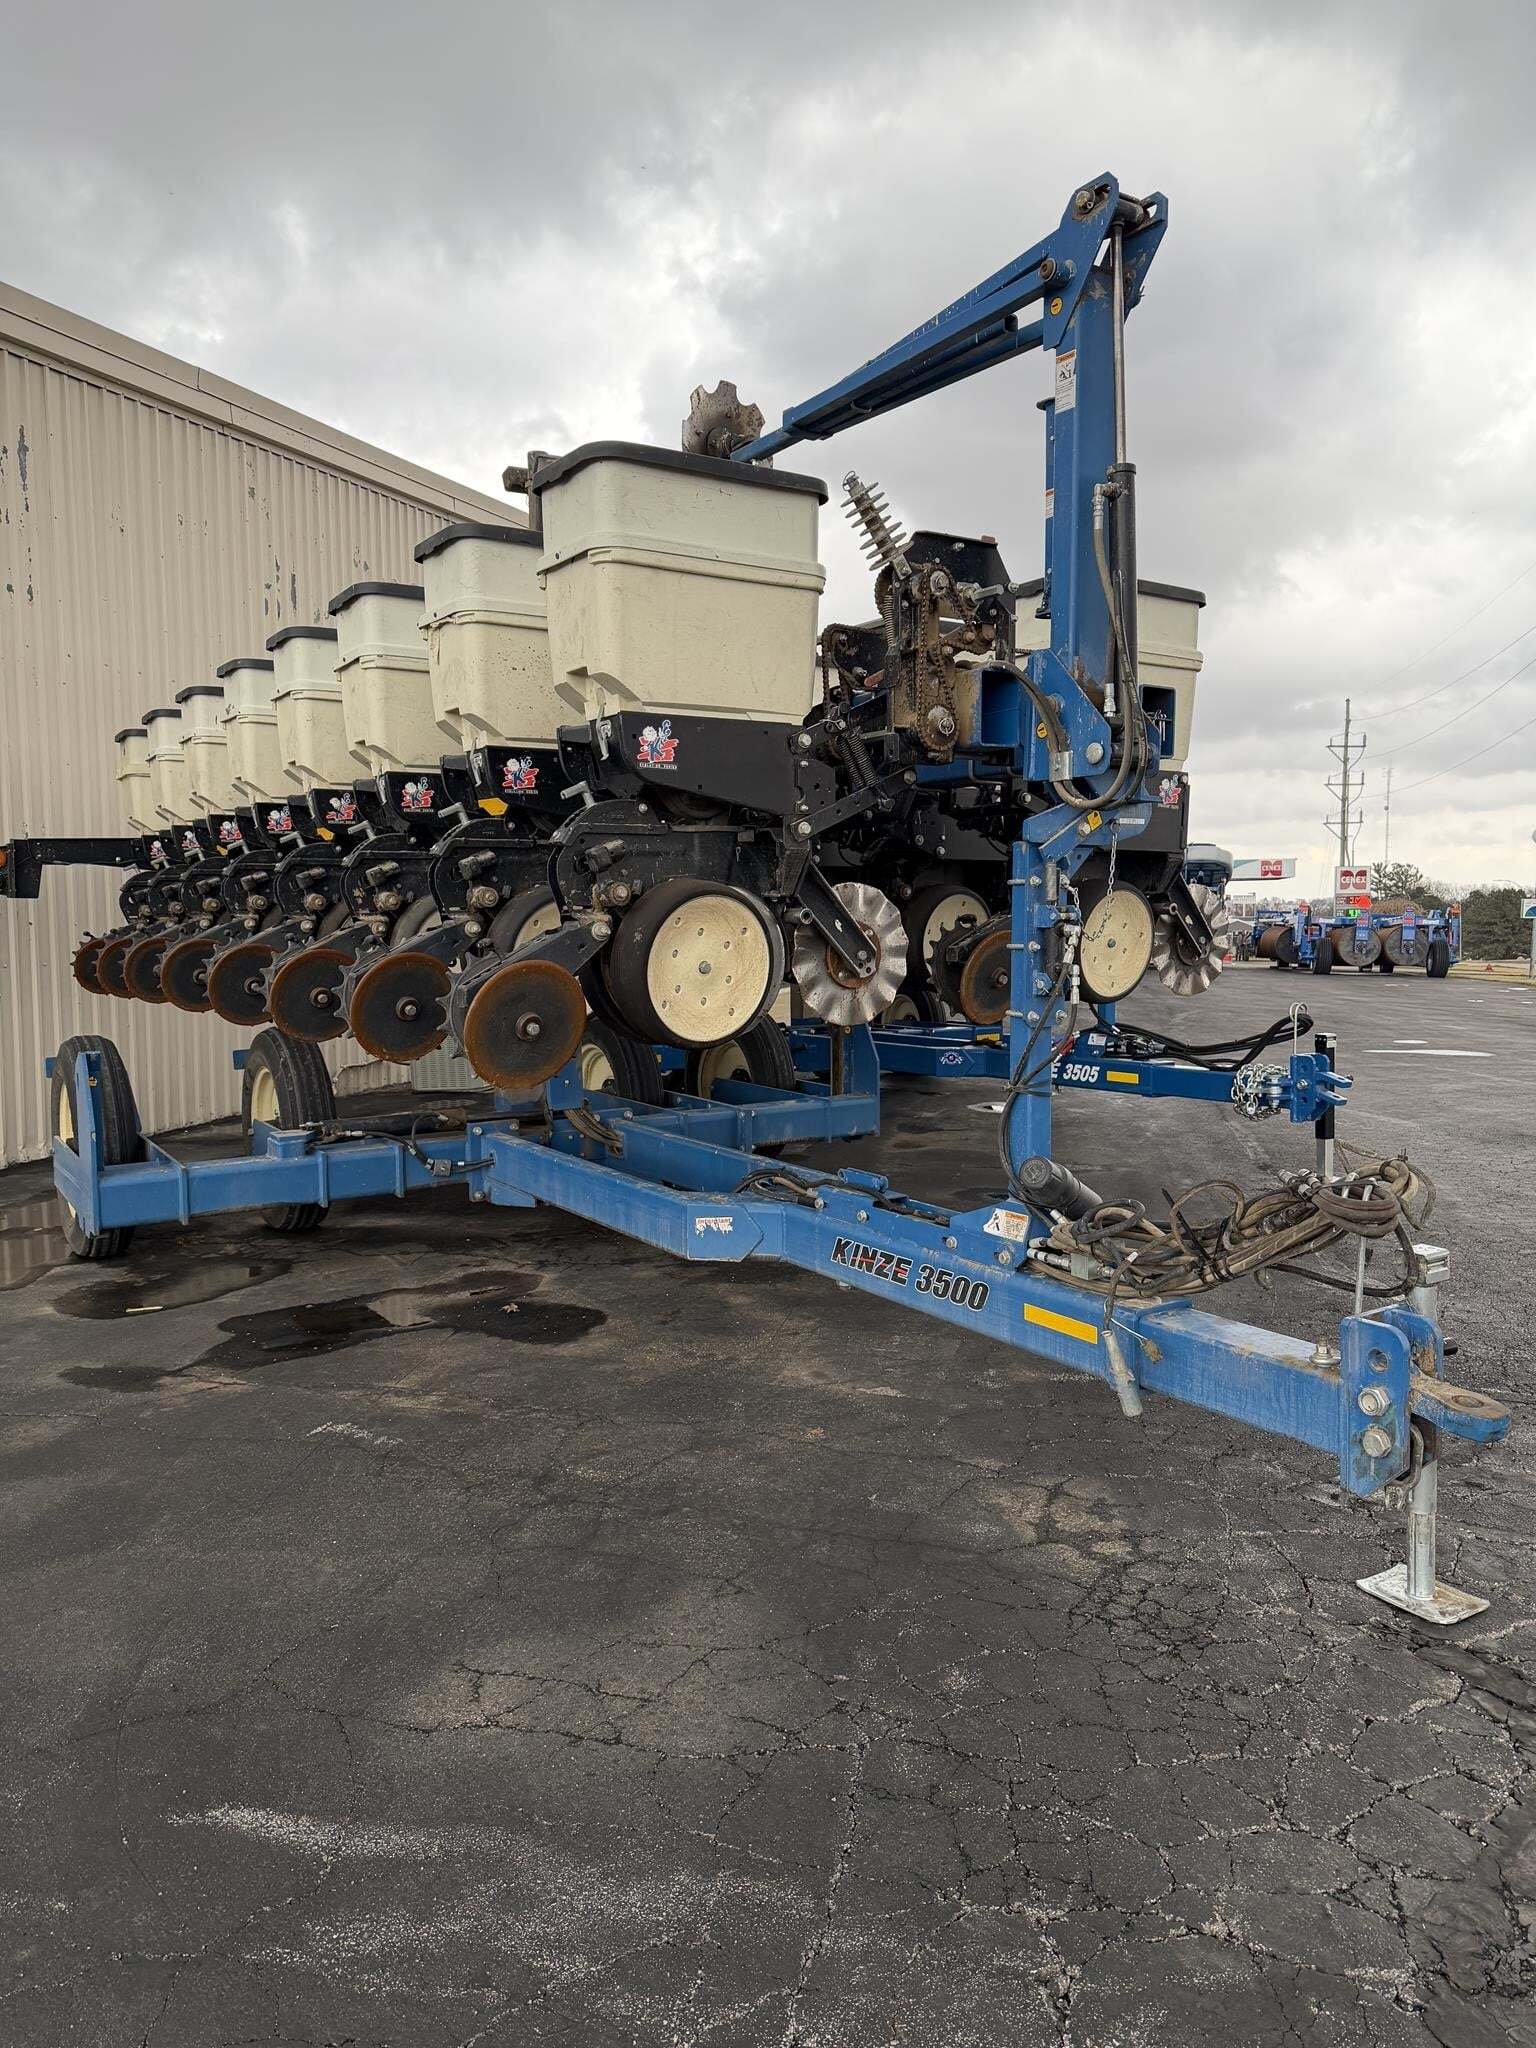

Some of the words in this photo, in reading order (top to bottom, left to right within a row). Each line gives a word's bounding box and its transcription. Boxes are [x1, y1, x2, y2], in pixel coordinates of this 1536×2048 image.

[1341, 876, 1366, 884] CENEX
[1063, 1063, 1100, 1083] 3505
[831, 1236, 913, 1286] KINZE
[915, 1263, 990, 1312] 3500
